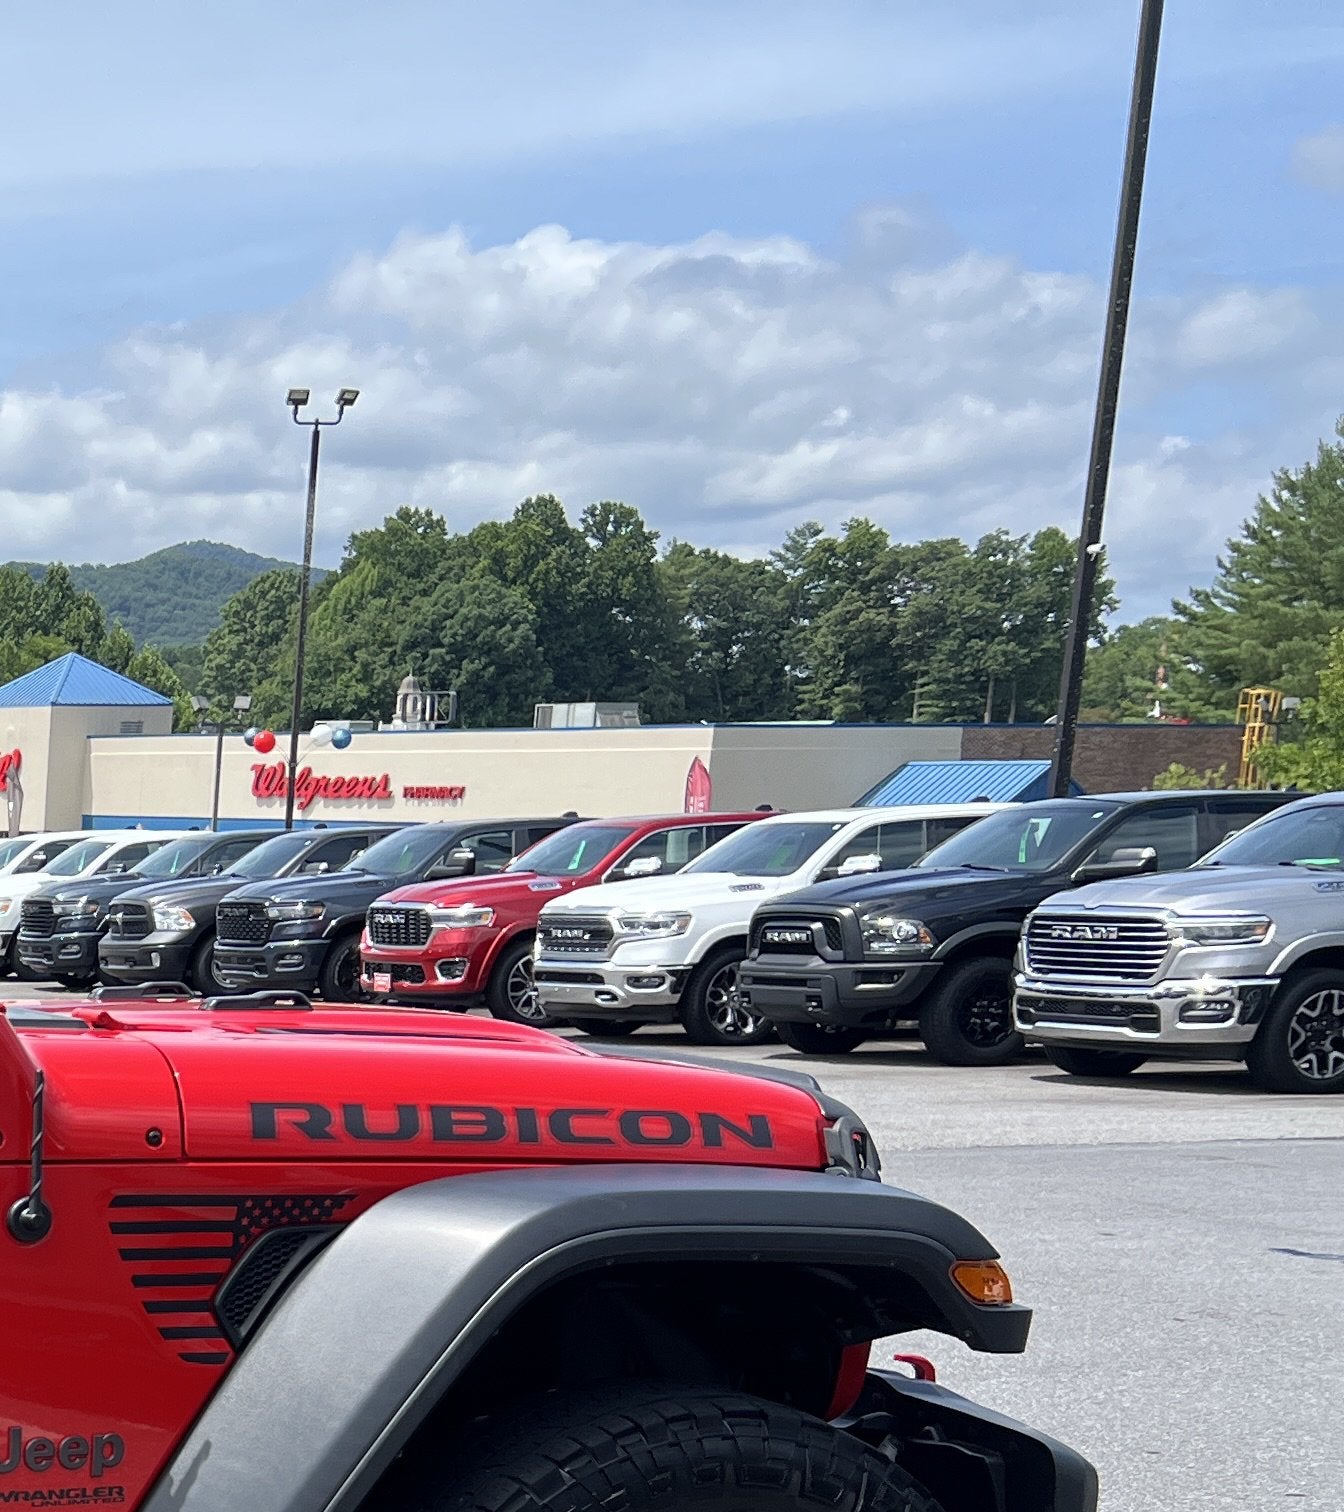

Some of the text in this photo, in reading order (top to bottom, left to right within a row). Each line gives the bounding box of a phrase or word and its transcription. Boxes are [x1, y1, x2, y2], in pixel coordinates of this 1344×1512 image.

[250, 760, 393, 811] Walgreens
[766, 931, 808, 942] RAM
[1051, 925, 1118, 940] RAM
[249, 1101, 774, 1150] RUBICON
[31, 1497, 126, 1508] UNLIMITED
